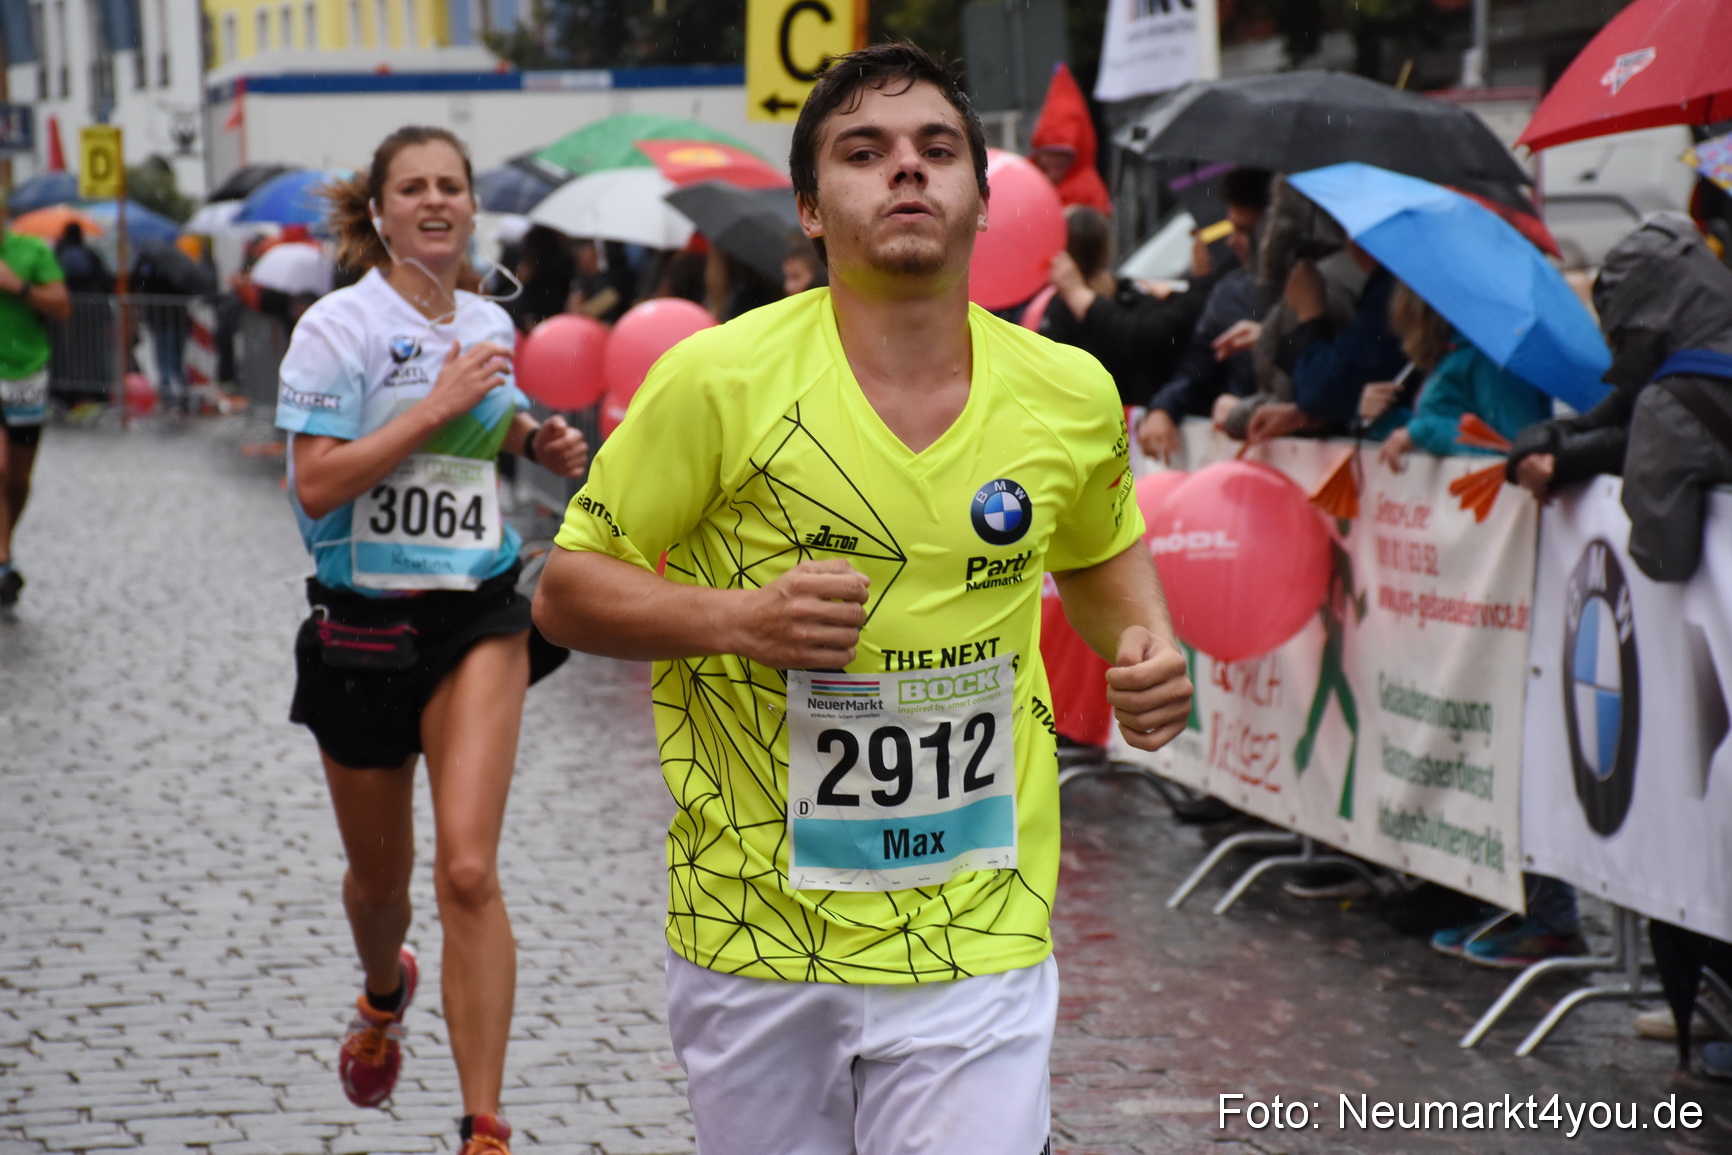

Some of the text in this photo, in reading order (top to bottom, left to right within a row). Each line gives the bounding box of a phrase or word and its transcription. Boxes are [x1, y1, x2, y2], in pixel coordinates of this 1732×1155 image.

[777, 0, 834, 84] C
[89, 147, 112, 180] D
[975, 480, 1027, 504] BMW
[369, 486, 486, 541] 3064
[966, 572, 1023, 592] Neumarkt
[881, 648, 933, 671] THE
[940, 637, 1001, 668] NEXT
[898, 664, 1001, 705] BOCK
[807, 697, 884, 711] NeuerMarkt
[898, 704, 933, 715] inspired
[935, 702, 946, 712] by
[947, 699, 971, 710] smart
[816, 711, 996, 807] 2912
[799, 801, 808, 815] D
[883, 828, 946, 861] Max
